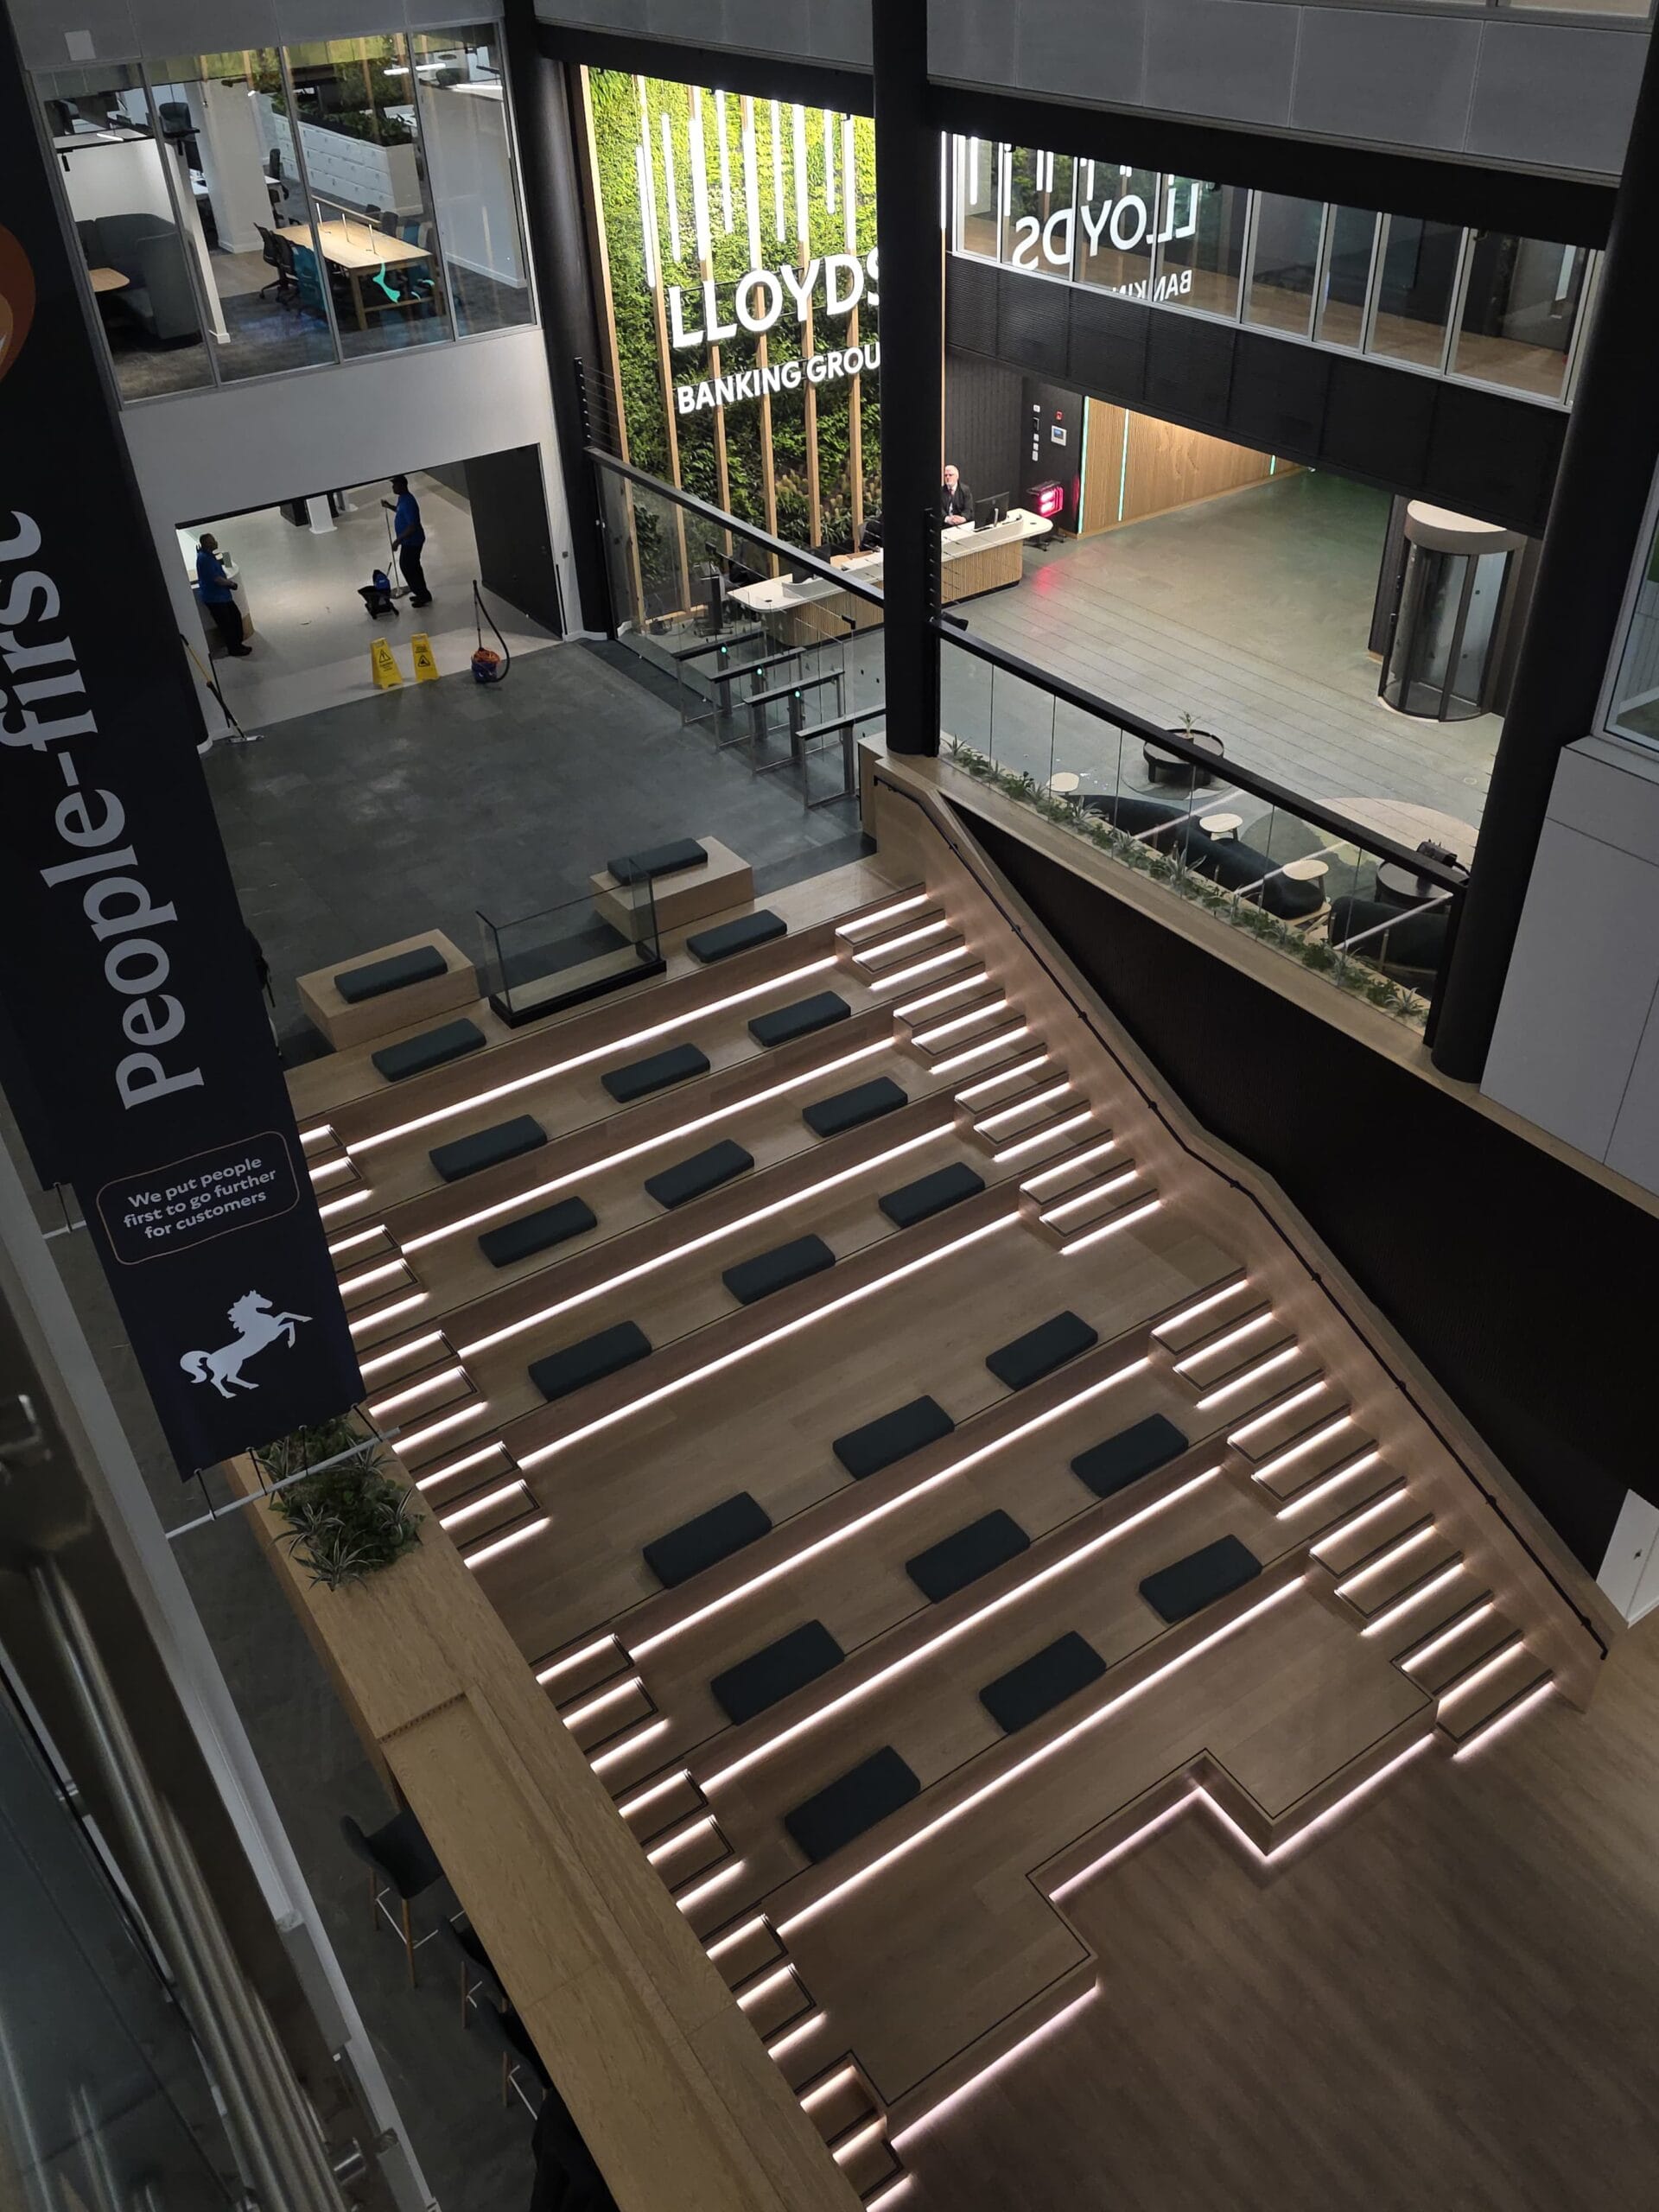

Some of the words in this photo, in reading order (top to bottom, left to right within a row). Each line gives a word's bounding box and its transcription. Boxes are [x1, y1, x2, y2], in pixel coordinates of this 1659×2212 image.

[677, 361, 802, 415] BANKING
[807, 342, 880, 383] GROU
[124, 1209, 163, 1228] first
[166, 1202, 187, 1216] to
[189, 1192, 212, 1210] go
[214, 1170, 276, 1198] further
[128, 1192, 162, 1207] We
[165, 1179, 198, 1200] put
[200, 1158, 262, 1187] people
[144, 1224, 172, 1239] for
[175, 1192, 266, 1230] customers
